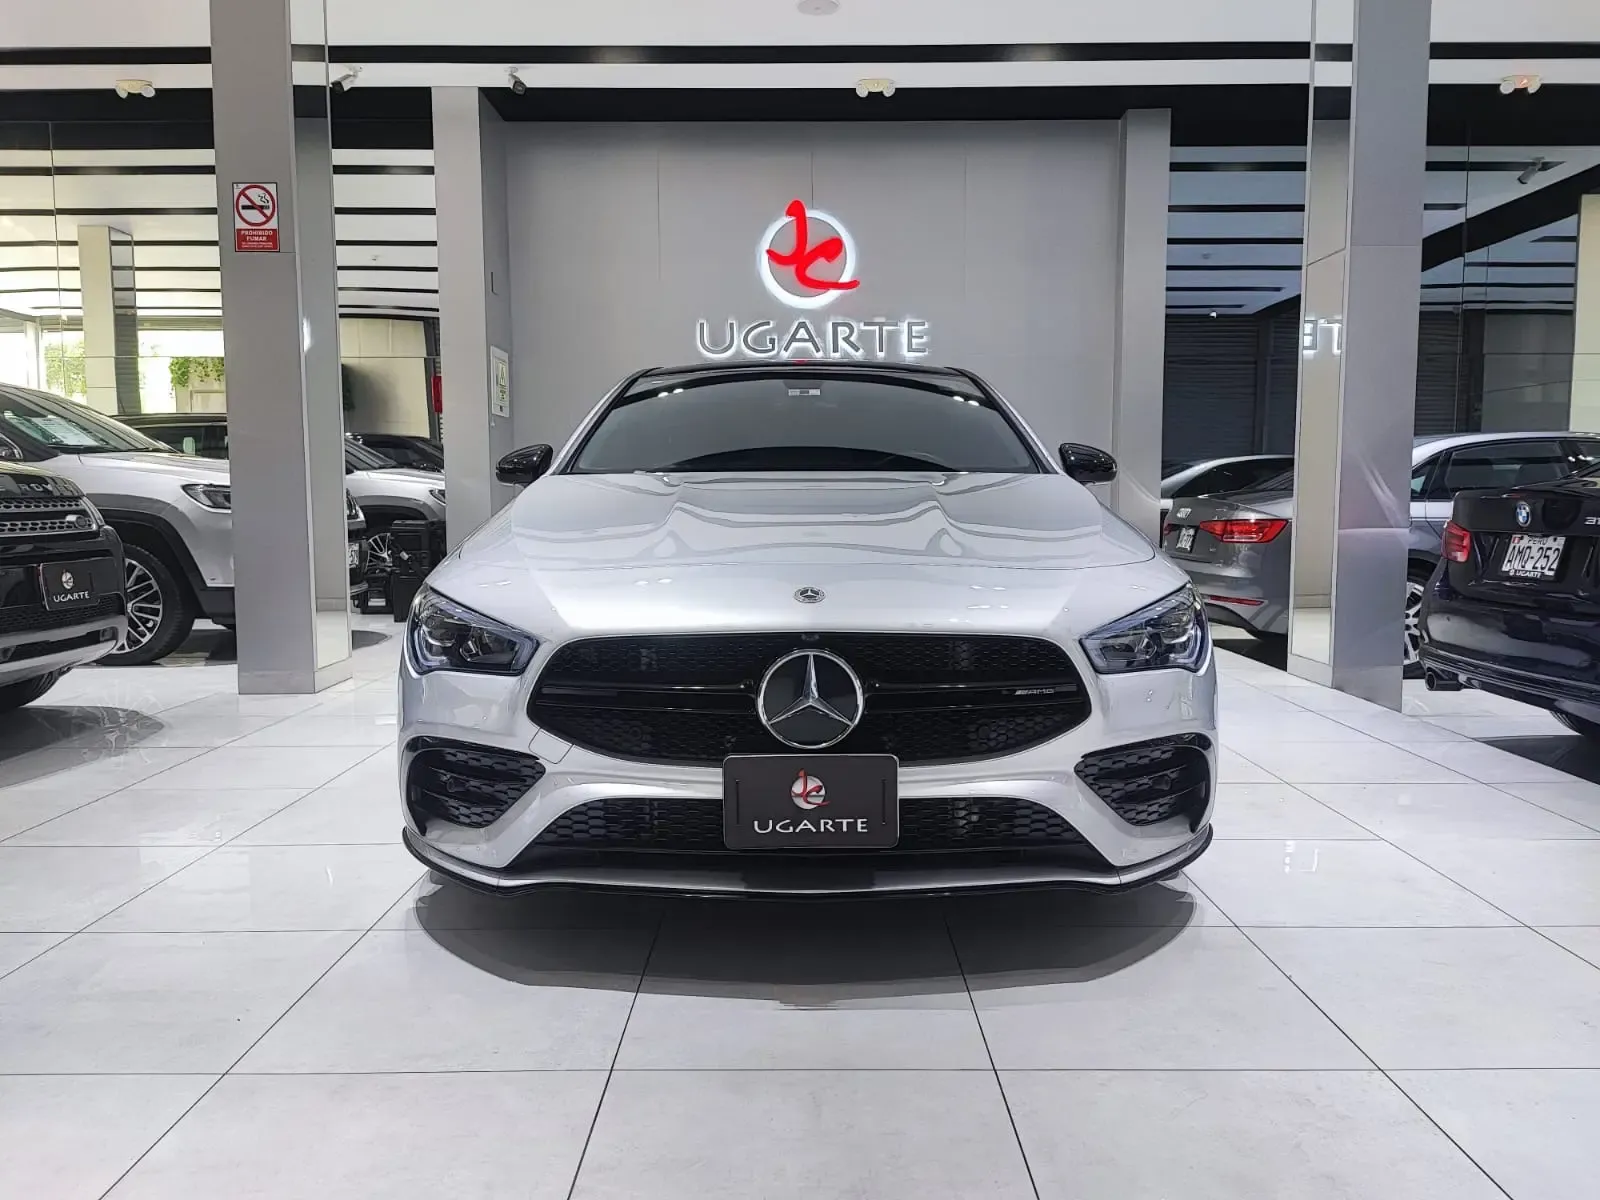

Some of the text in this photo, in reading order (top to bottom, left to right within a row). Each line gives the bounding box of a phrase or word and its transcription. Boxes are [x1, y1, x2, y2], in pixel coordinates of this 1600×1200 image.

[697, 319, 929, 355] UGARTE
[53, 591, 90, 602] UGARTE
[753, 818, 868, 834] UGARTE
